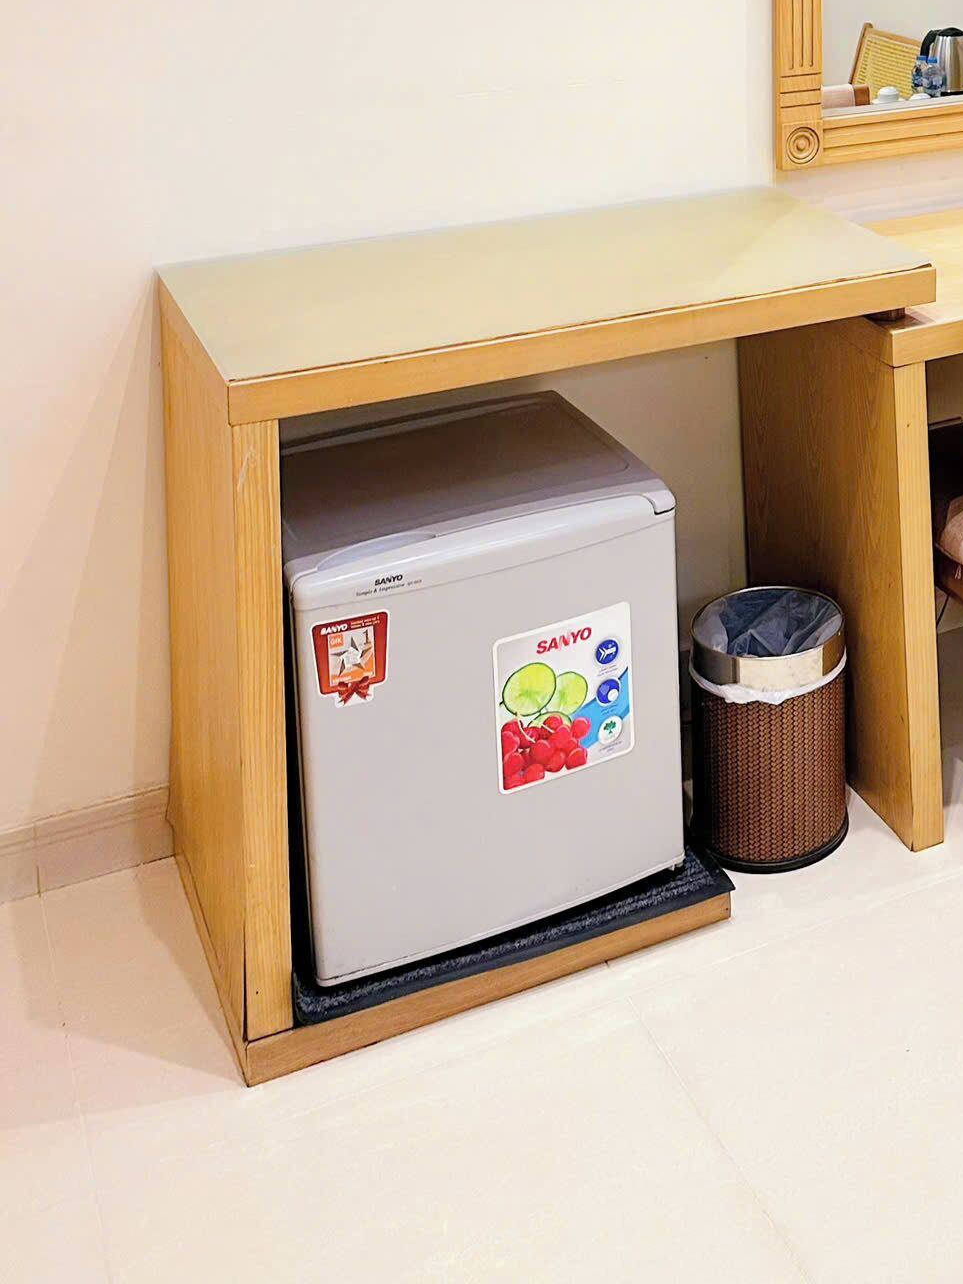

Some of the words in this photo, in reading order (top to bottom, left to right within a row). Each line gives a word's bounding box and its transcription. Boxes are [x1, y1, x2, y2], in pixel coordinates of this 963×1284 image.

[375, 574, 403, 586] SANYO
[320, 623, 348, 635] SANYO
[536, 627, 592, 654] SANYO
